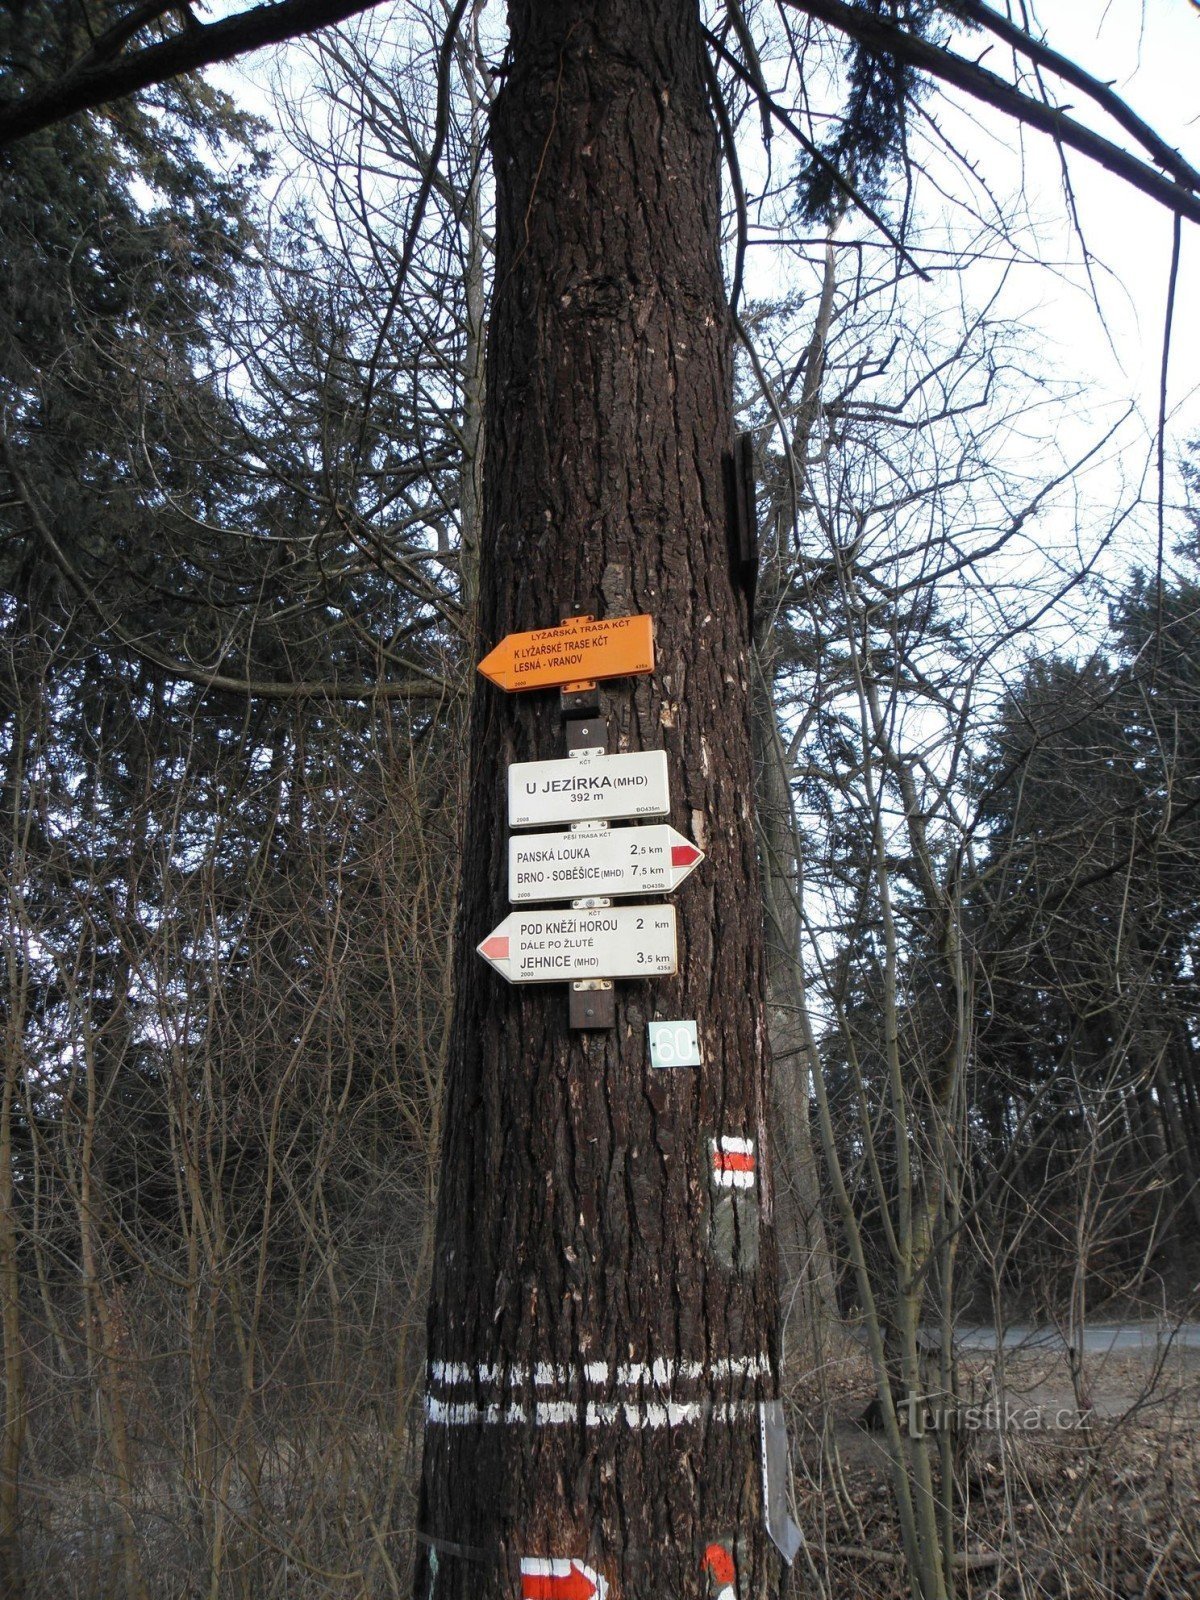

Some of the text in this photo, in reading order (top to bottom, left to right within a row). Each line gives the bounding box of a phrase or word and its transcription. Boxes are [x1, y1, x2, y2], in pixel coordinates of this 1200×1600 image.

[580, 624, 610, 634] TRASA
[612, 619, 630, 629] KČT
[514, 636, 608, 659] K LYŽAŘSKÉ TRASE KČT
[514, 658, 541, 673] LESNÁ
[548, 654, 582, 668] VRANOV
[526, 776, 648, 794] U JEZÍRKA (MHD)
[570, 792, 590, 802] 392
[517, 844, 663, 863] PANSKÁ LOUKA 2,5 km
[517, 871, 544, 884] BRNO
[552, 866, 600, 881] SOBĚŠICE
[600, 869, 624, 880] (MHD)
[631, 864, 648, 876] 7,5
[650, 866, 664, 875] km
[520, 918, 670, 935] POD KNĚŽÍ HOROU 2 km
[520, 938, 594, 950] DÁLE PO ŽLUTÉ
[520, 952, 670, 969] JEHNICE (MHD) 3,5 km
[656, 1026, 692, 1062] 60
